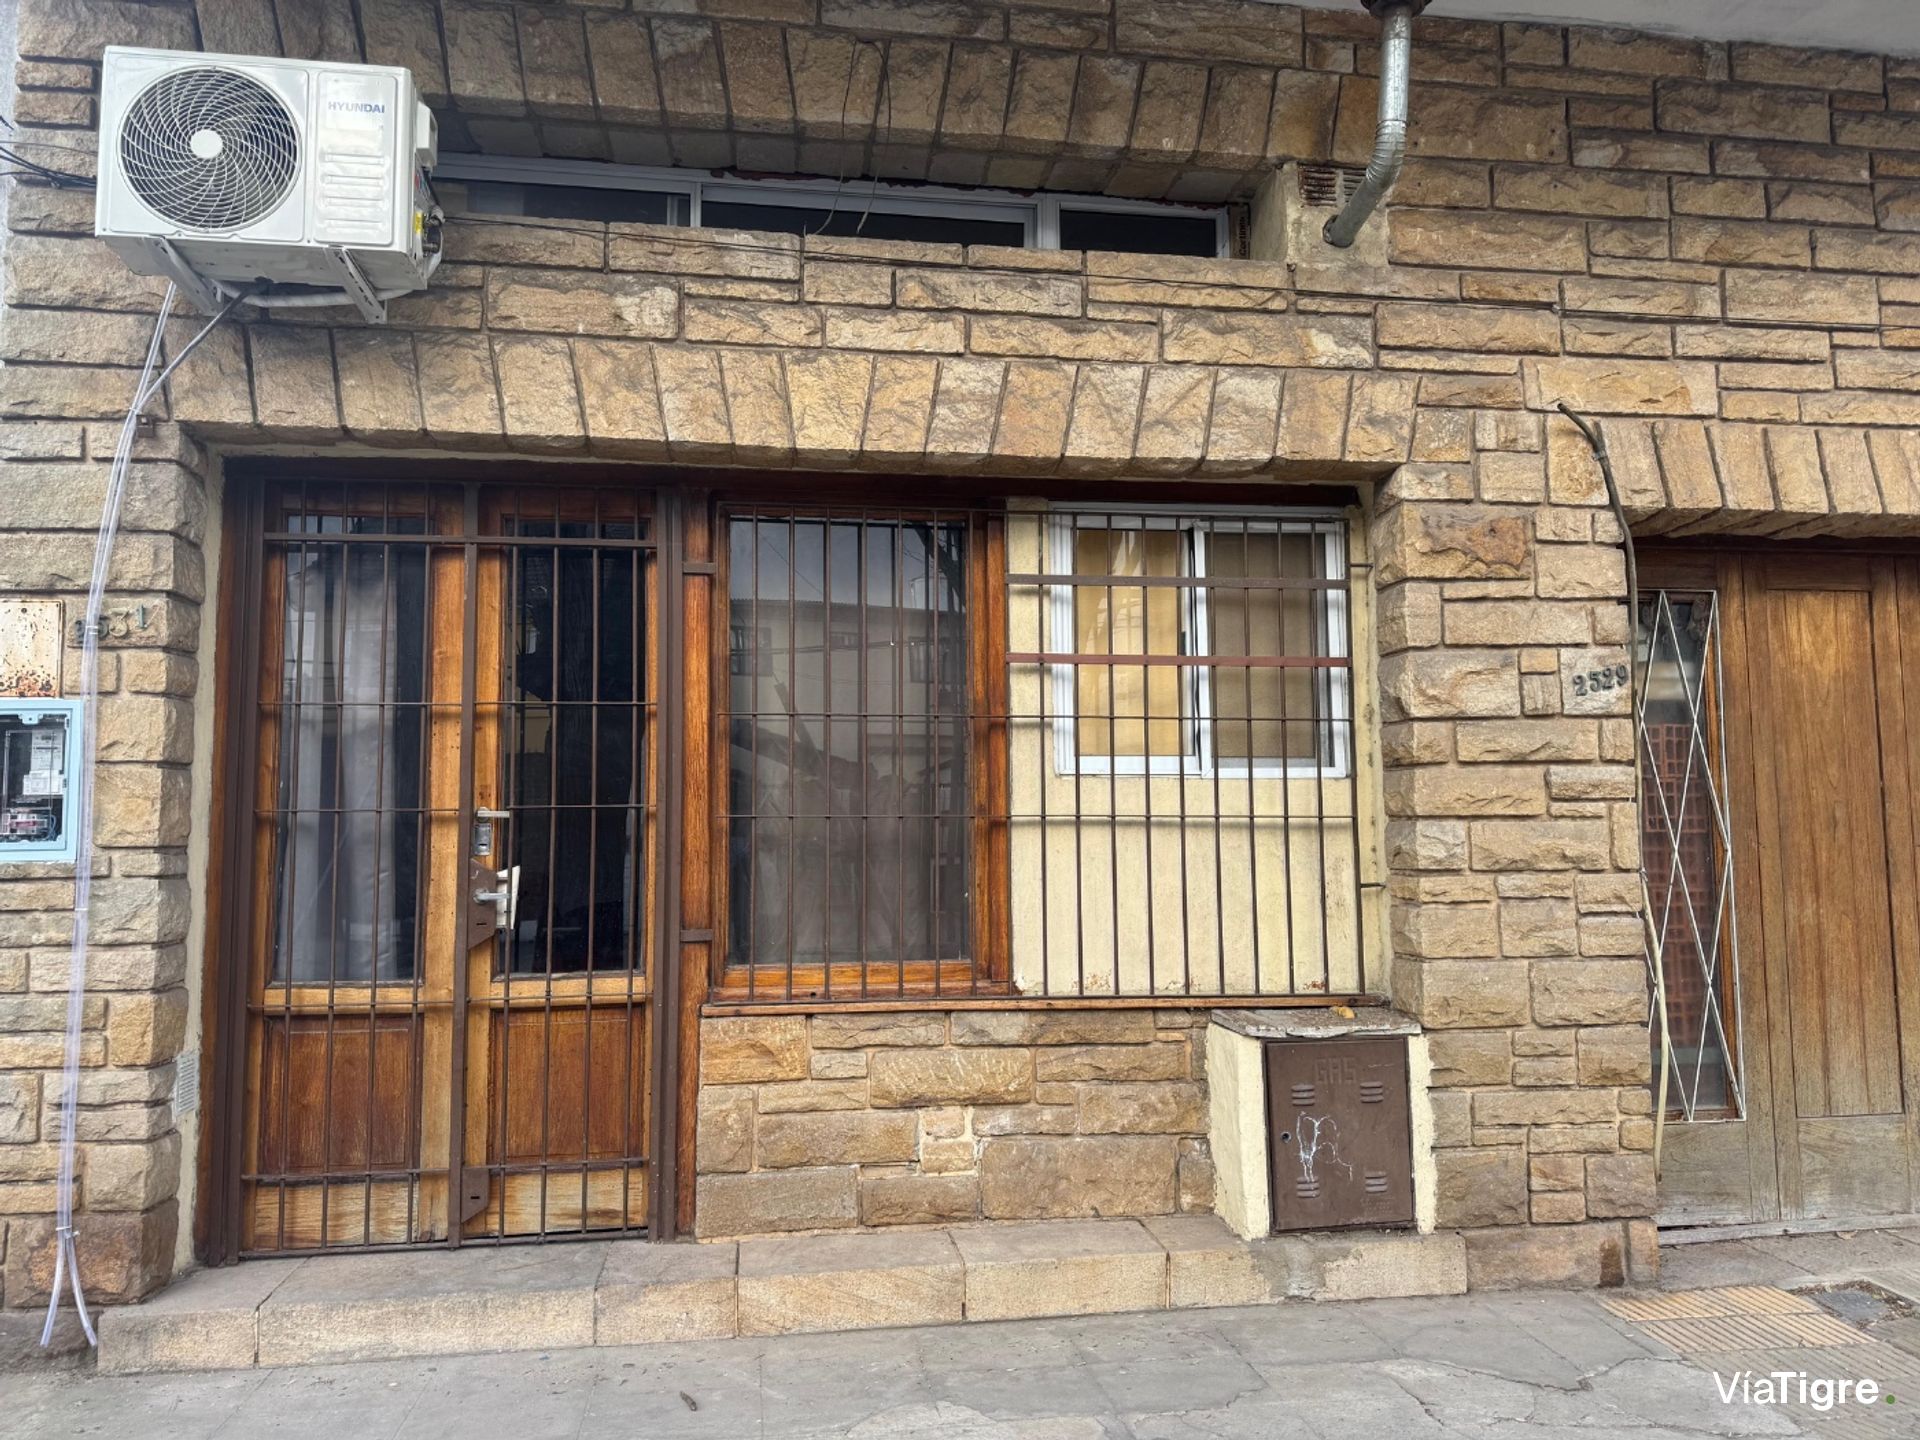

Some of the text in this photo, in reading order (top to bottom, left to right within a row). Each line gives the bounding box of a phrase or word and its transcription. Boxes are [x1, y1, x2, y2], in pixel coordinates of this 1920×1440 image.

[328, 101, 385, 113] HYUNDAI
[1573, 665, 1629, 696] 2529
[1315, 1057, 1357, 1085] GAS
